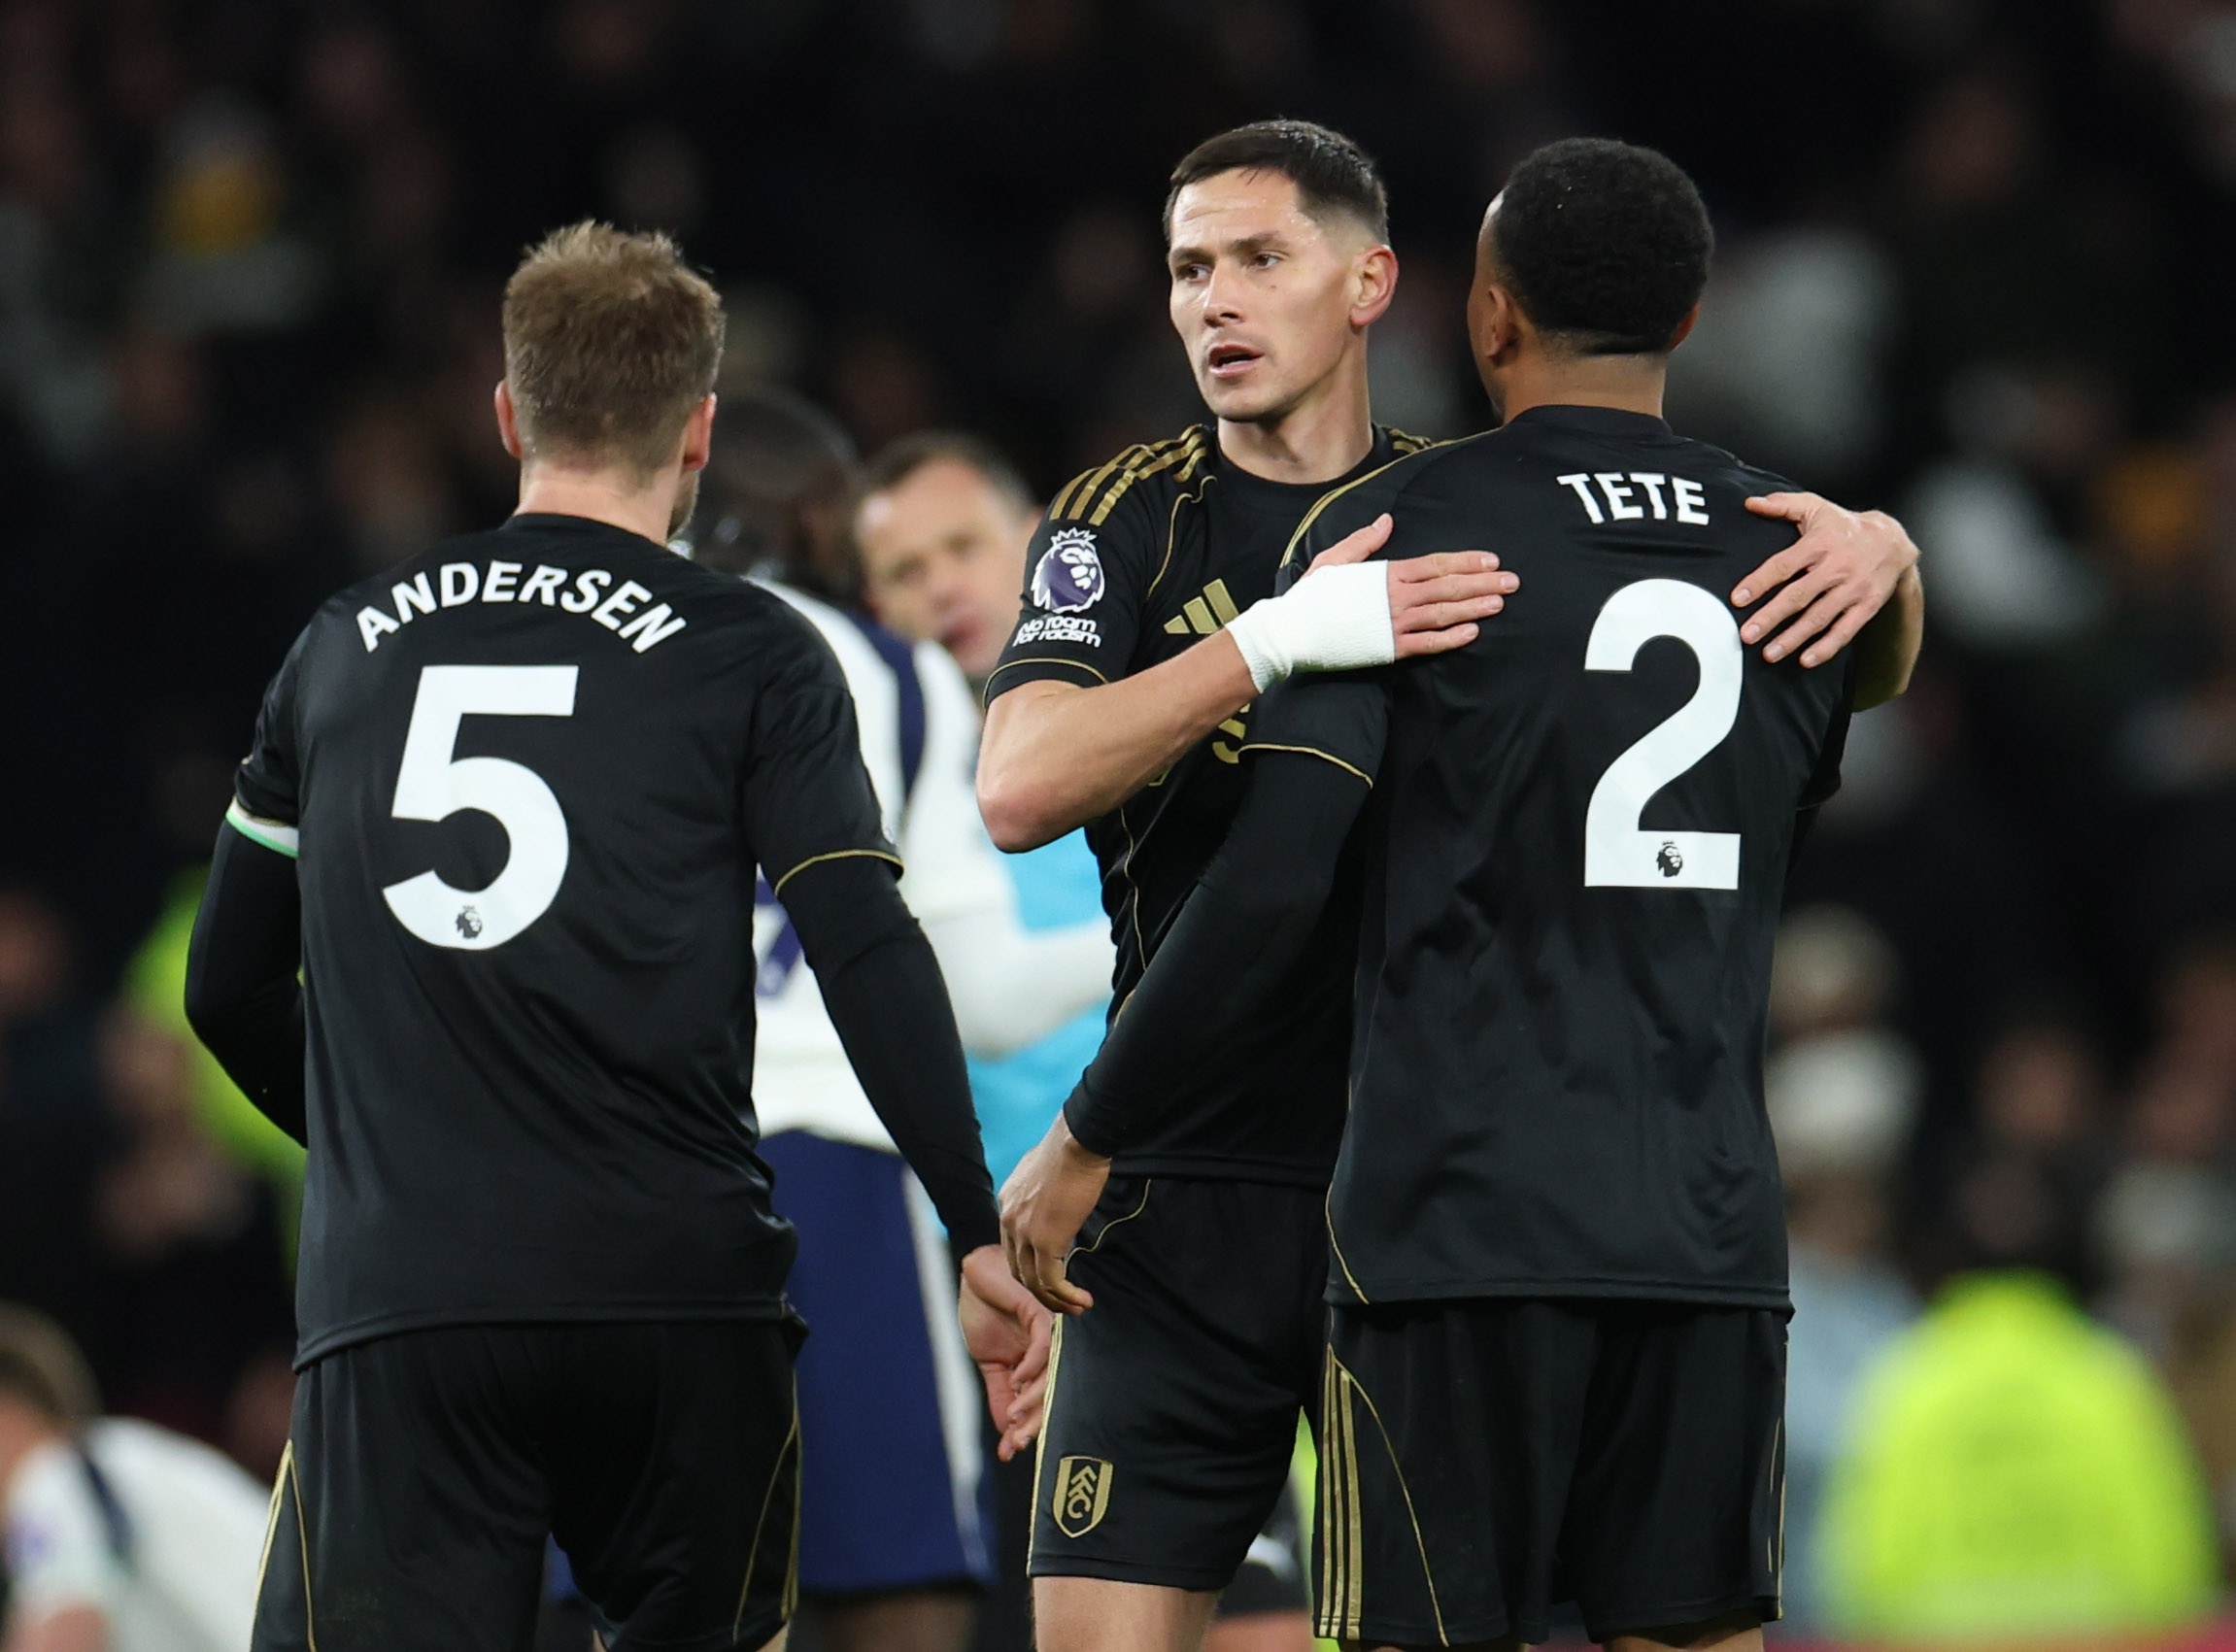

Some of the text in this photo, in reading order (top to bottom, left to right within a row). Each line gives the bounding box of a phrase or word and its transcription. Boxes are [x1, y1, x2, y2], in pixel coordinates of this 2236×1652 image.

[1557, 472, 1710, 525] TETE
[356, 559, 687, 654] ANDERSEN
[1012, 628, 1101, 648] for racism
[1018, 616, 1097, 633] No room
[1584, 579, 1742, 890] 2
[383, 665, 579, 951] 5
